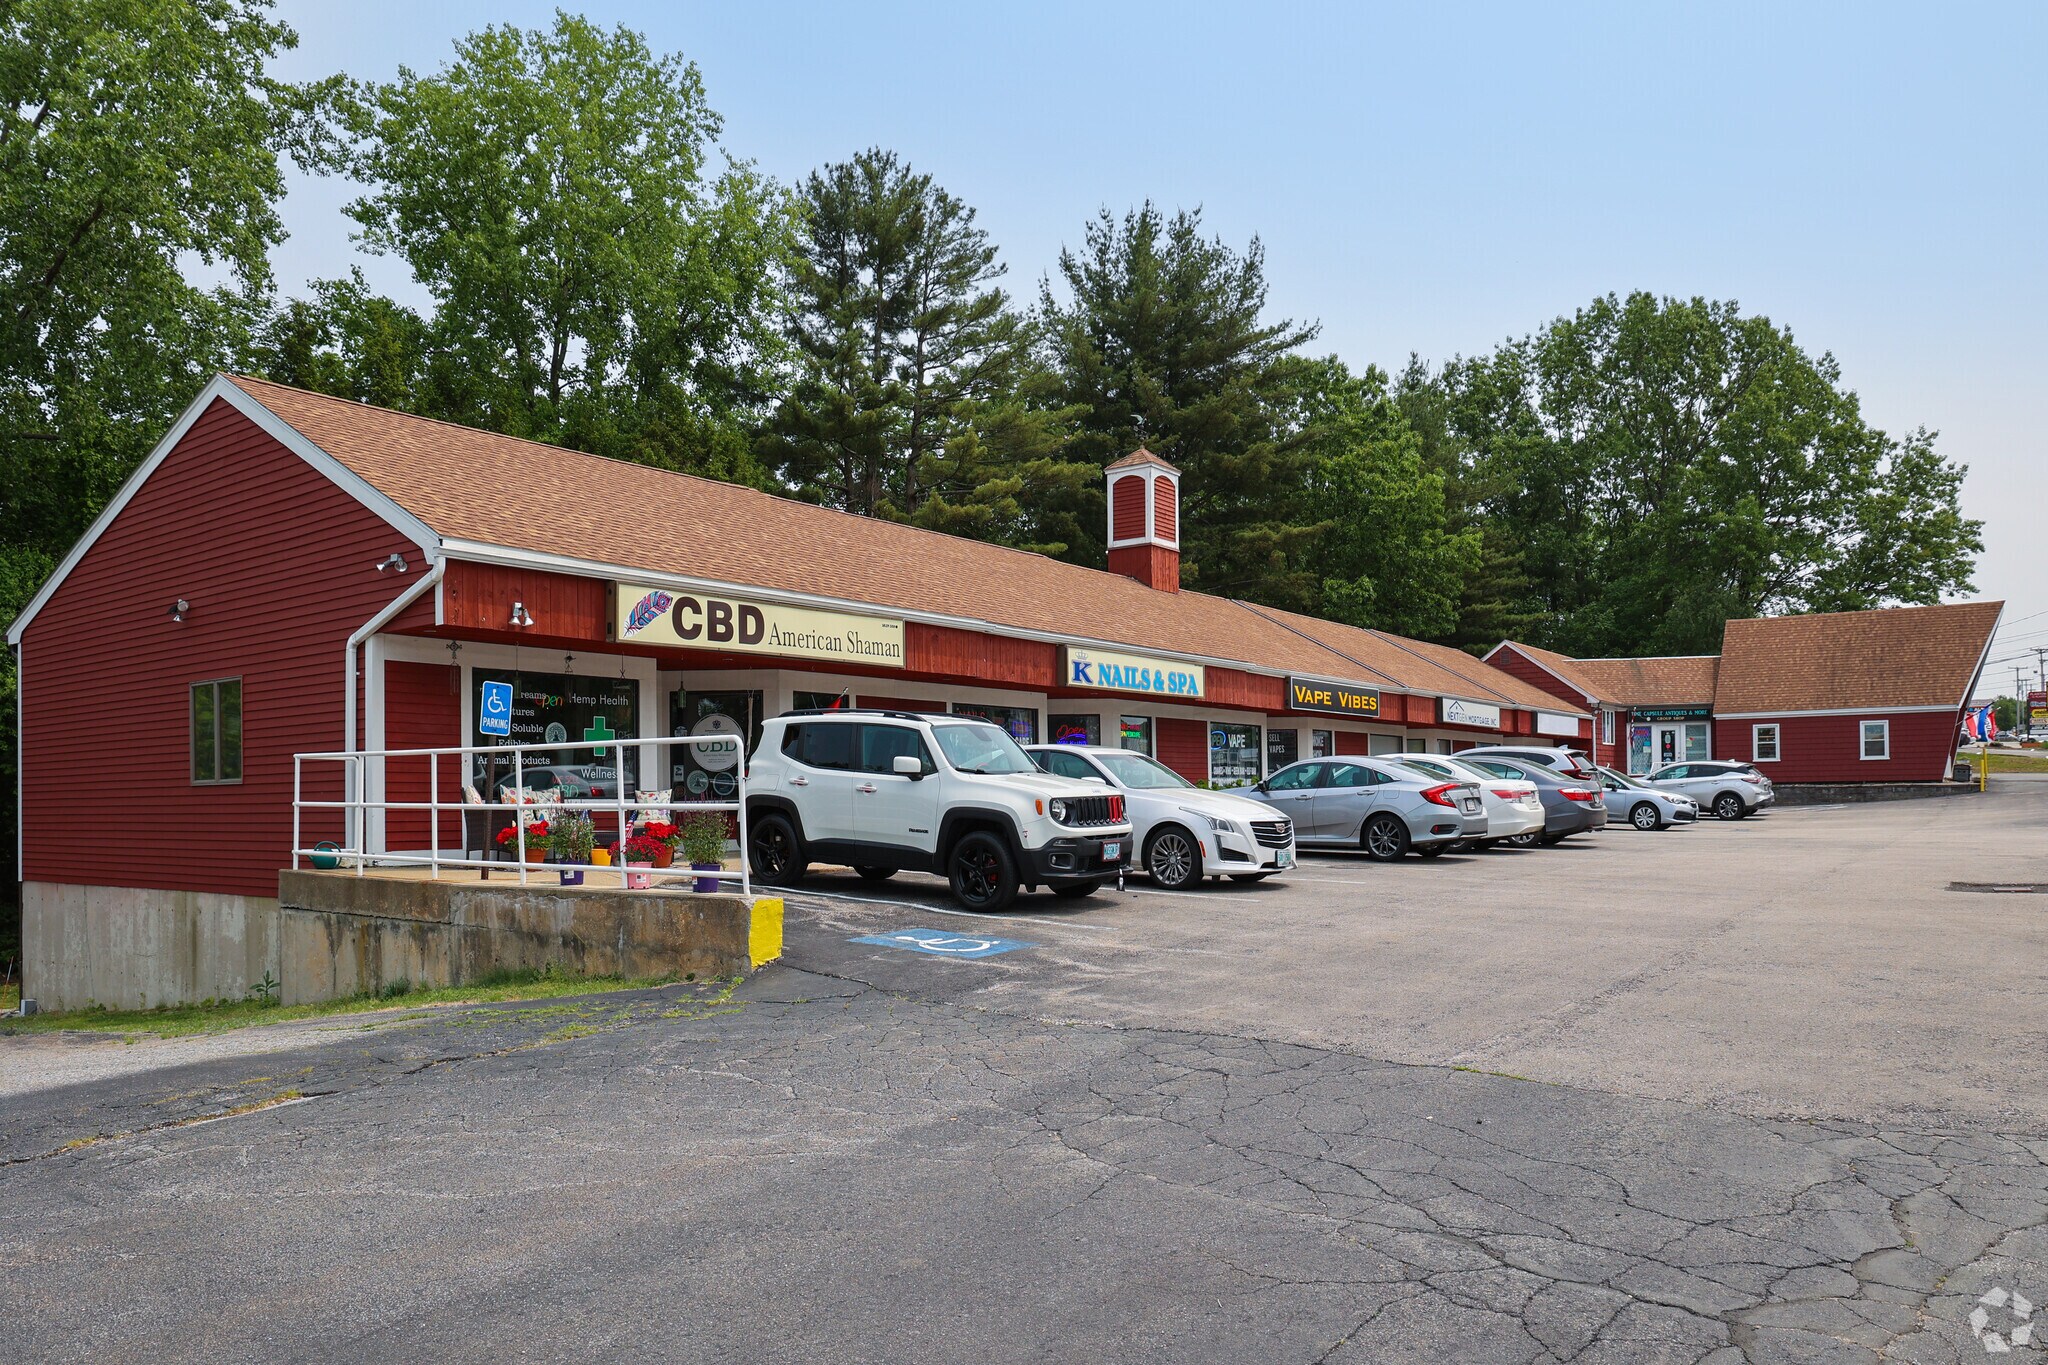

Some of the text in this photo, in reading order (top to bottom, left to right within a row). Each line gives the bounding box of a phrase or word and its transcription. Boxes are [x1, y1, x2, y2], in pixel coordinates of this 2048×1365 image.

[672, 596, 900, 658] CBD American Shaman
[1072, 660, 1198, 696] K NAILS & SPA
[519, 691, 547, 699] reams
[569, 692, 629, 706] Hemp Health
[482, 716, 509, 730] PARKING
[511, 723, 544, 733] Soluble
[1227, 733, 1246, 748] VAPE
[1268, 733, 1281, 742] SELL
[1268, 744, 1285, 754] VAPES
[478, 755, 551, 765] Anmal Poducts
[580, 767, 619, 779] Wellnes
